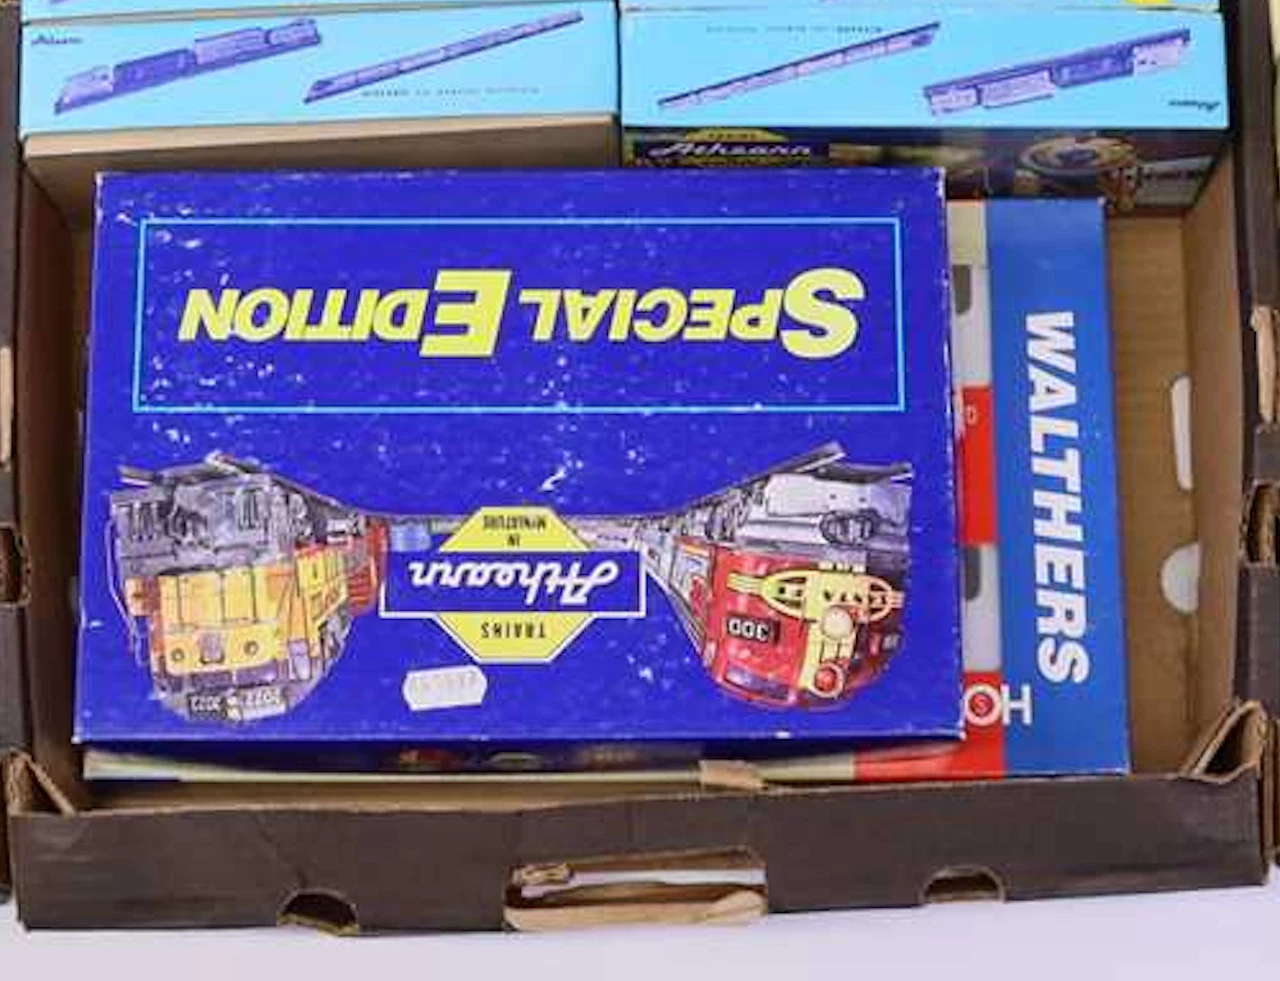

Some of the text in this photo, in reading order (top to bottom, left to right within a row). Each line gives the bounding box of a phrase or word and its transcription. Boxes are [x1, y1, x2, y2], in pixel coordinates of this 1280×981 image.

[176, 266, 866, 360] SPECIAL EDITION
[1024, 310, 1090, 683] WALTHERS
[482, 513, 548, 529] MINIATURE
[508, 533, 521, 547] IN
[407, 559, 619, 607] Athearn
[479, 621, 546, 639] TRAINS
